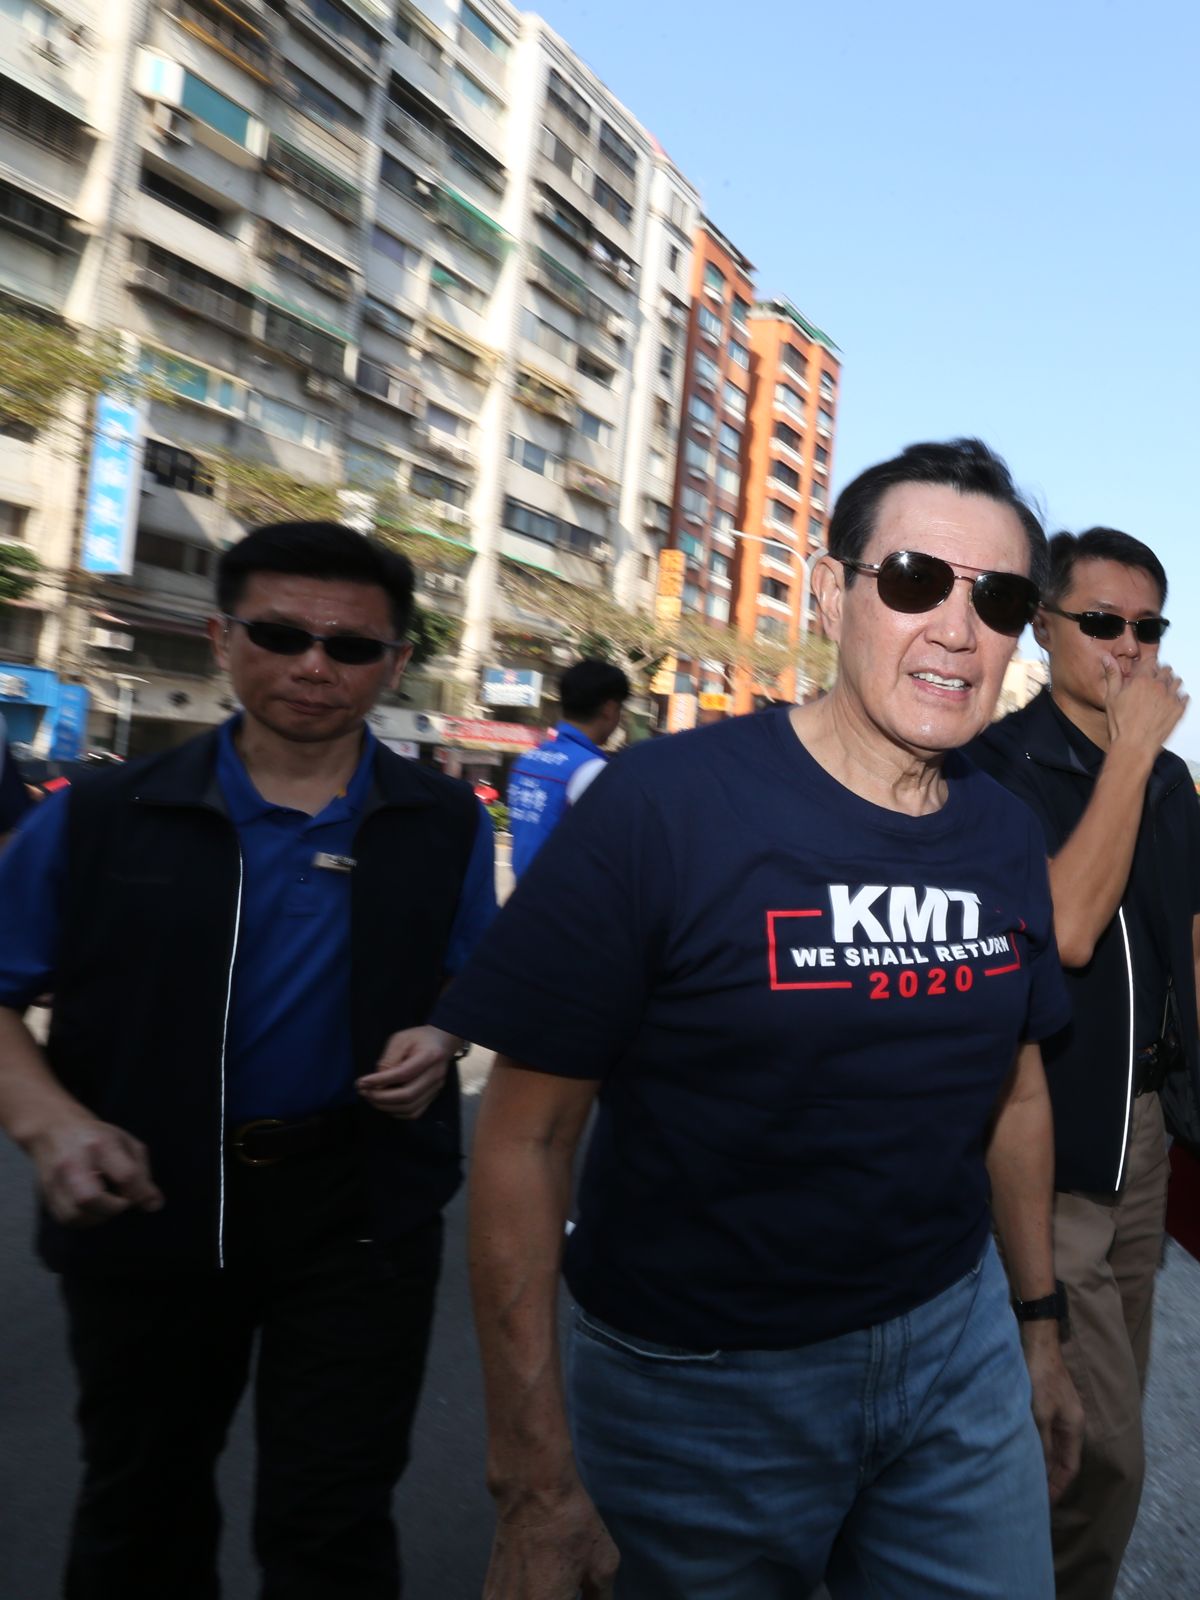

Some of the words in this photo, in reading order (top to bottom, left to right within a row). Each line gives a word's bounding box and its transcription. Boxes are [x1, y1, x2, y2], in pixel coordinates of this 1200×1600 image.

[828, 883, 982, 943] KMT
[791, 947, 836, 968] WE
[844, 946, 929, 967] SHALL
[935, 935, 1010, 963] RETURN
[869, 965, 974, 1000] 2020
